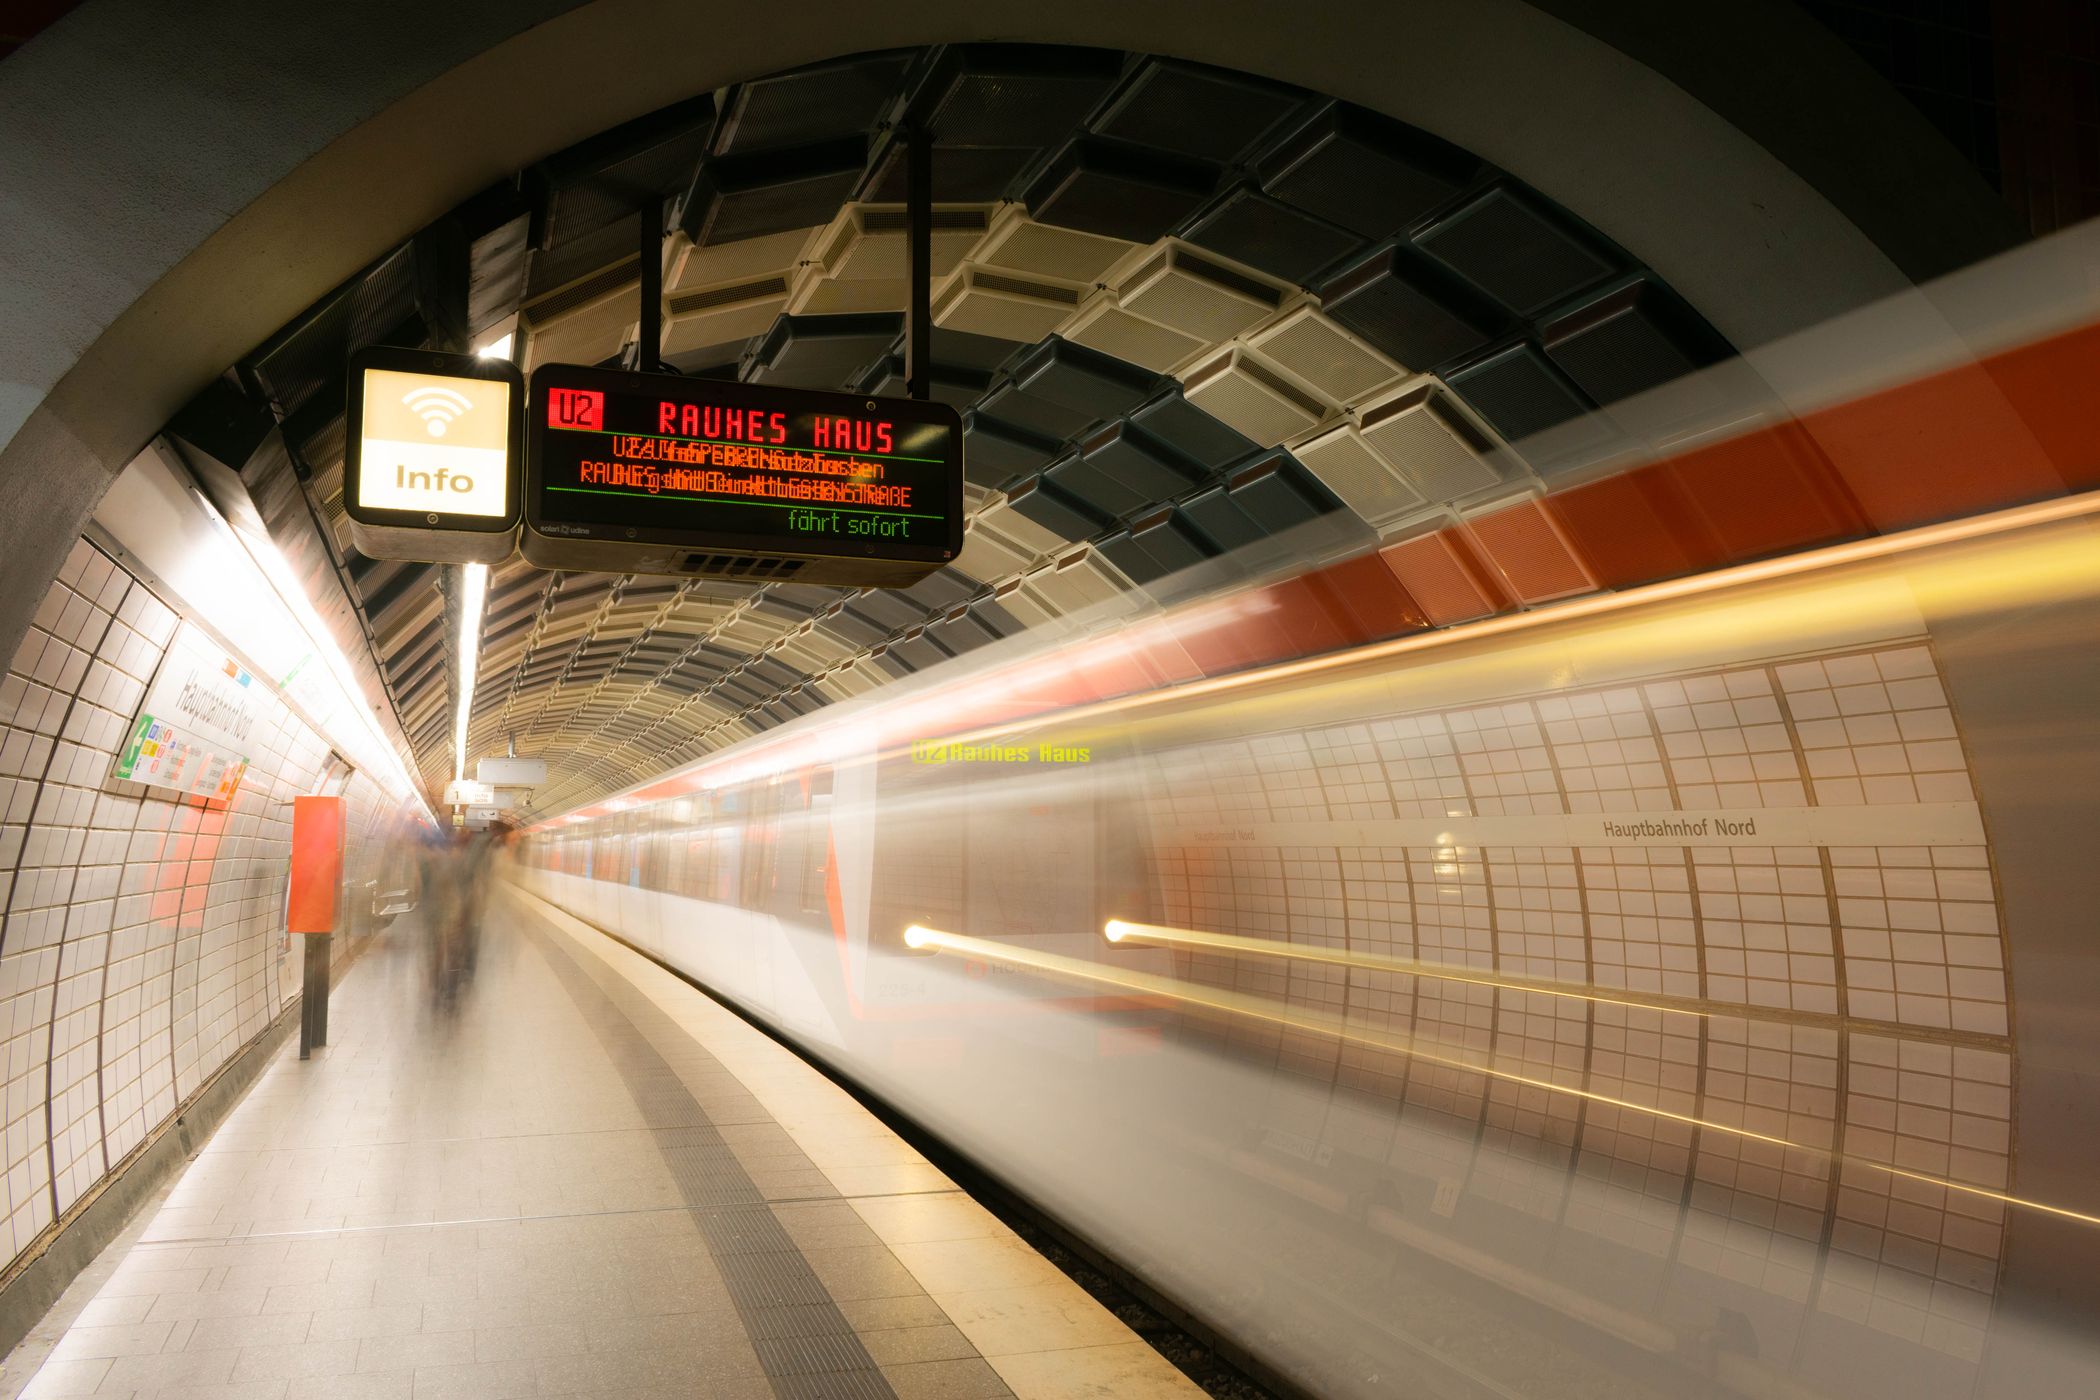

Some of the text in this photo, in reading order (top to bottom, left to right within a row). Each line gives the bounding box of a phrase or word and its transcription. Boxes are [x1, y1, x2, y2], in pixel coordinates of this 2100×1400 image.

[559, 392, 593, 426] U2
[659, 402, 893, 453] RAUHES HAUS
[396, 464, 474, 494] Info
[789, 510, 910, 538] fährt sofort
[951, 743, 1029, 762] Rauhes
[1039, 743, 1091, 763] Haus
[1603, 817, 1757, 841] Hauptbahnhof Nord
